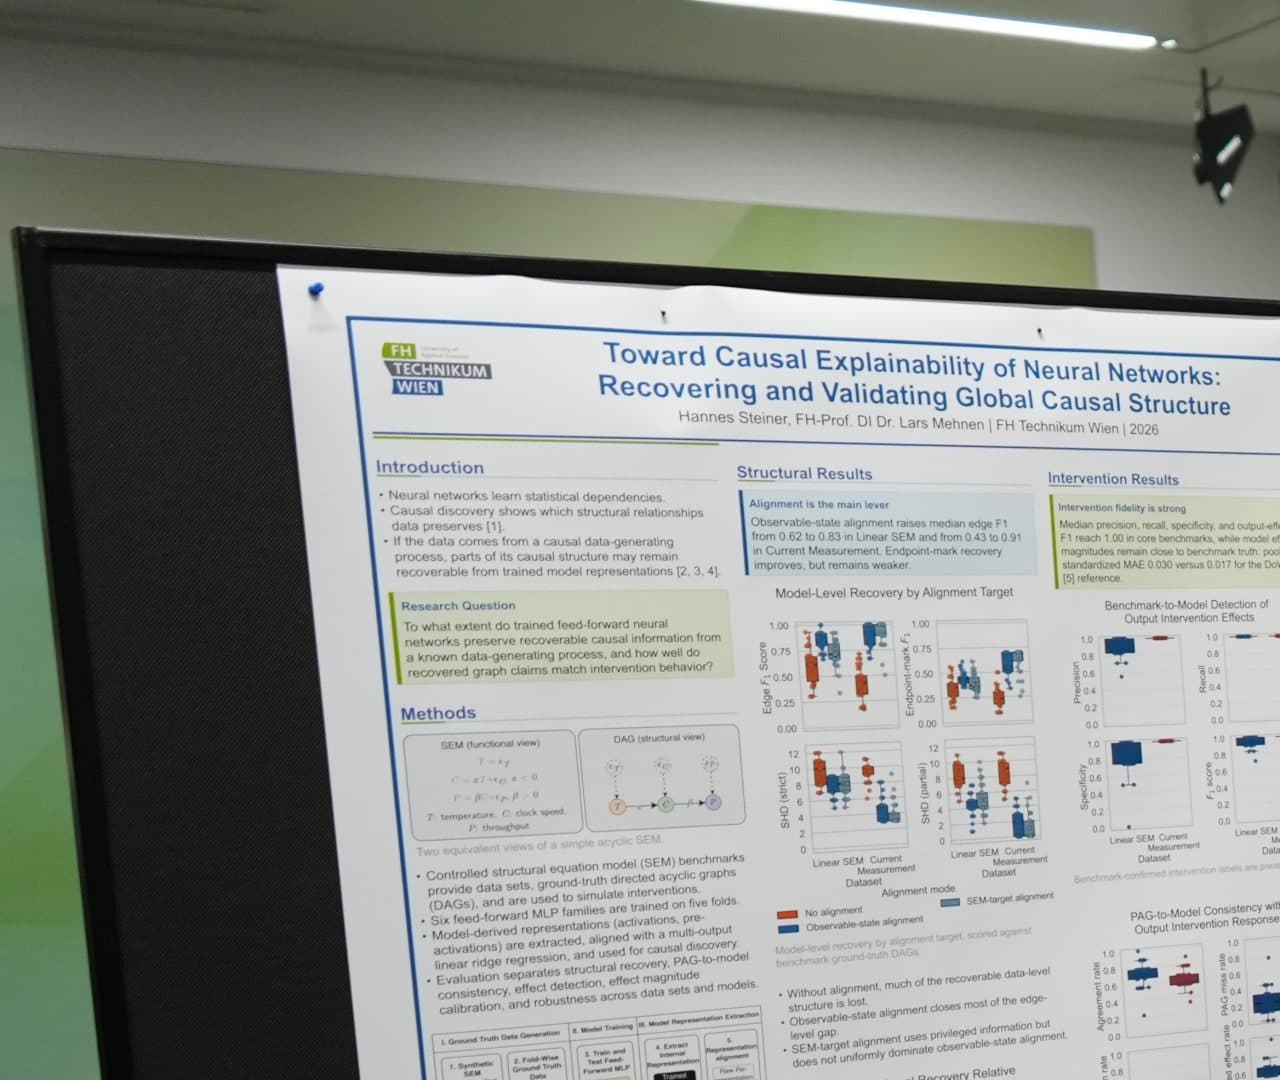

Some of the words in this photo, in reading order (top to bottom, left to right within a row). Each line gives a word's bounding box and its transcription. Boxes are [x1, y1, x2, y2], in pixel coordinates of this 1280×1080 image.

[391, 344, 412, 357] FH
[393, 362, 488, 378] TECHNIKUM
[602, 341, 706, 367] Toward
[715, 345, 807, 369] Causal
[815, 348, 985, 382] Explainability
[993, 358, 1016, 378] of
[1023, 359, 1100, 381] Neural
[1108, 362, 1220, 386] Networks:
[396, 381, 439, 394] WIEN
[598, 373, 757, 406] Recovering
[765, 380, 814, 402] and
[820, 381, 947, 412] Validating
[955, 386, 1034, 409] Global
[1041, 389, 1121, 412] Causal
[1128, 392, 1231, 416] Structure
[678, 409, 735, 424] Hannes
[738, 410, 791, 427] Steiner,
[795, 412, 853, 427] FH-Prof.
[857, 414, 872, 427] DI
[876, 415, 895, 428] Dr.
[899, 415, 929, 429] Lars
[932, 416, 985, 431] Mehnen
[995, 418, 1015, 431] FH
[1018, 419, 1085, 433] Technikum
[1087, 421, 1119, 434] Wien
[1129, 423, 1159, 436] 2026
[376, 459, 484, 474] Introduction
[736, 465, 812, 479] Structural
[816, 467, 873, 481] Results
[1048, 471, 1127, 485] Intervention
[1131, 473, 1180, 486] Results
[388, 489, 430, 501] Neural
[433, 490, 489, 502] networks
[491, 490, 522, 501] learn
[524, 491, 580, 502] statistical
[582, 491, 665, 504] dependencies.
[748, 498, 803, 511] Alignment
[805, 499, 815, 509] is
[817, 499, 834, 509] the
[836, 500, 862, 509] main
[864, 500, 889, 509] lever
[1058, 503, 1114, 512] Intervention
[1115, 503, 1145, 515] fidelity
[1147, 503, 1156, 512] is
[1157, 504, 1186, 515] strong
[775, 587, 847, 599] Model-Level
[849, 587, 904, 600] Recovery
[906, 586, 920, 600] by
[922, 586, 977, 600] Alignment
[979, 586, 1014, 600] Target
[401, 601, 459, 611] Research
[461, 600, 516, 611] Question
[1104, 599, 1208, 611] Benchmark-to-Model
[1210, 599, 1257, 610] Detection
[1259, 598, 1269, 609] of
[1123, 613, 1158, 625] Output
[1160, 613, 1219, 623] Intervention
[1221, 611, 1255, 623] Effects
[407, 666, 469, 678] recovered
[472, 665, 507, 679] graph
[510, 665, 549, 676] claims
[551, 664, 587, 675] match
[590, 663, 656, 674] intervention
[658, 661, 713, 673] behavior?
[400, 705, 477, 721] Methods
[804, 908, 819, 918] No
[819, 905, 863, 918] alignment
[786, 986, 827, 999] Without
[829, 981, 882, 997] alignment,
[884, 978, 912, 990] much
[914, 976, 924, 988] of
[926, 976, 943, 986] the
[944, 970, 1002, 984] recoverable
[1003, 965, 1051, 979] data-level
